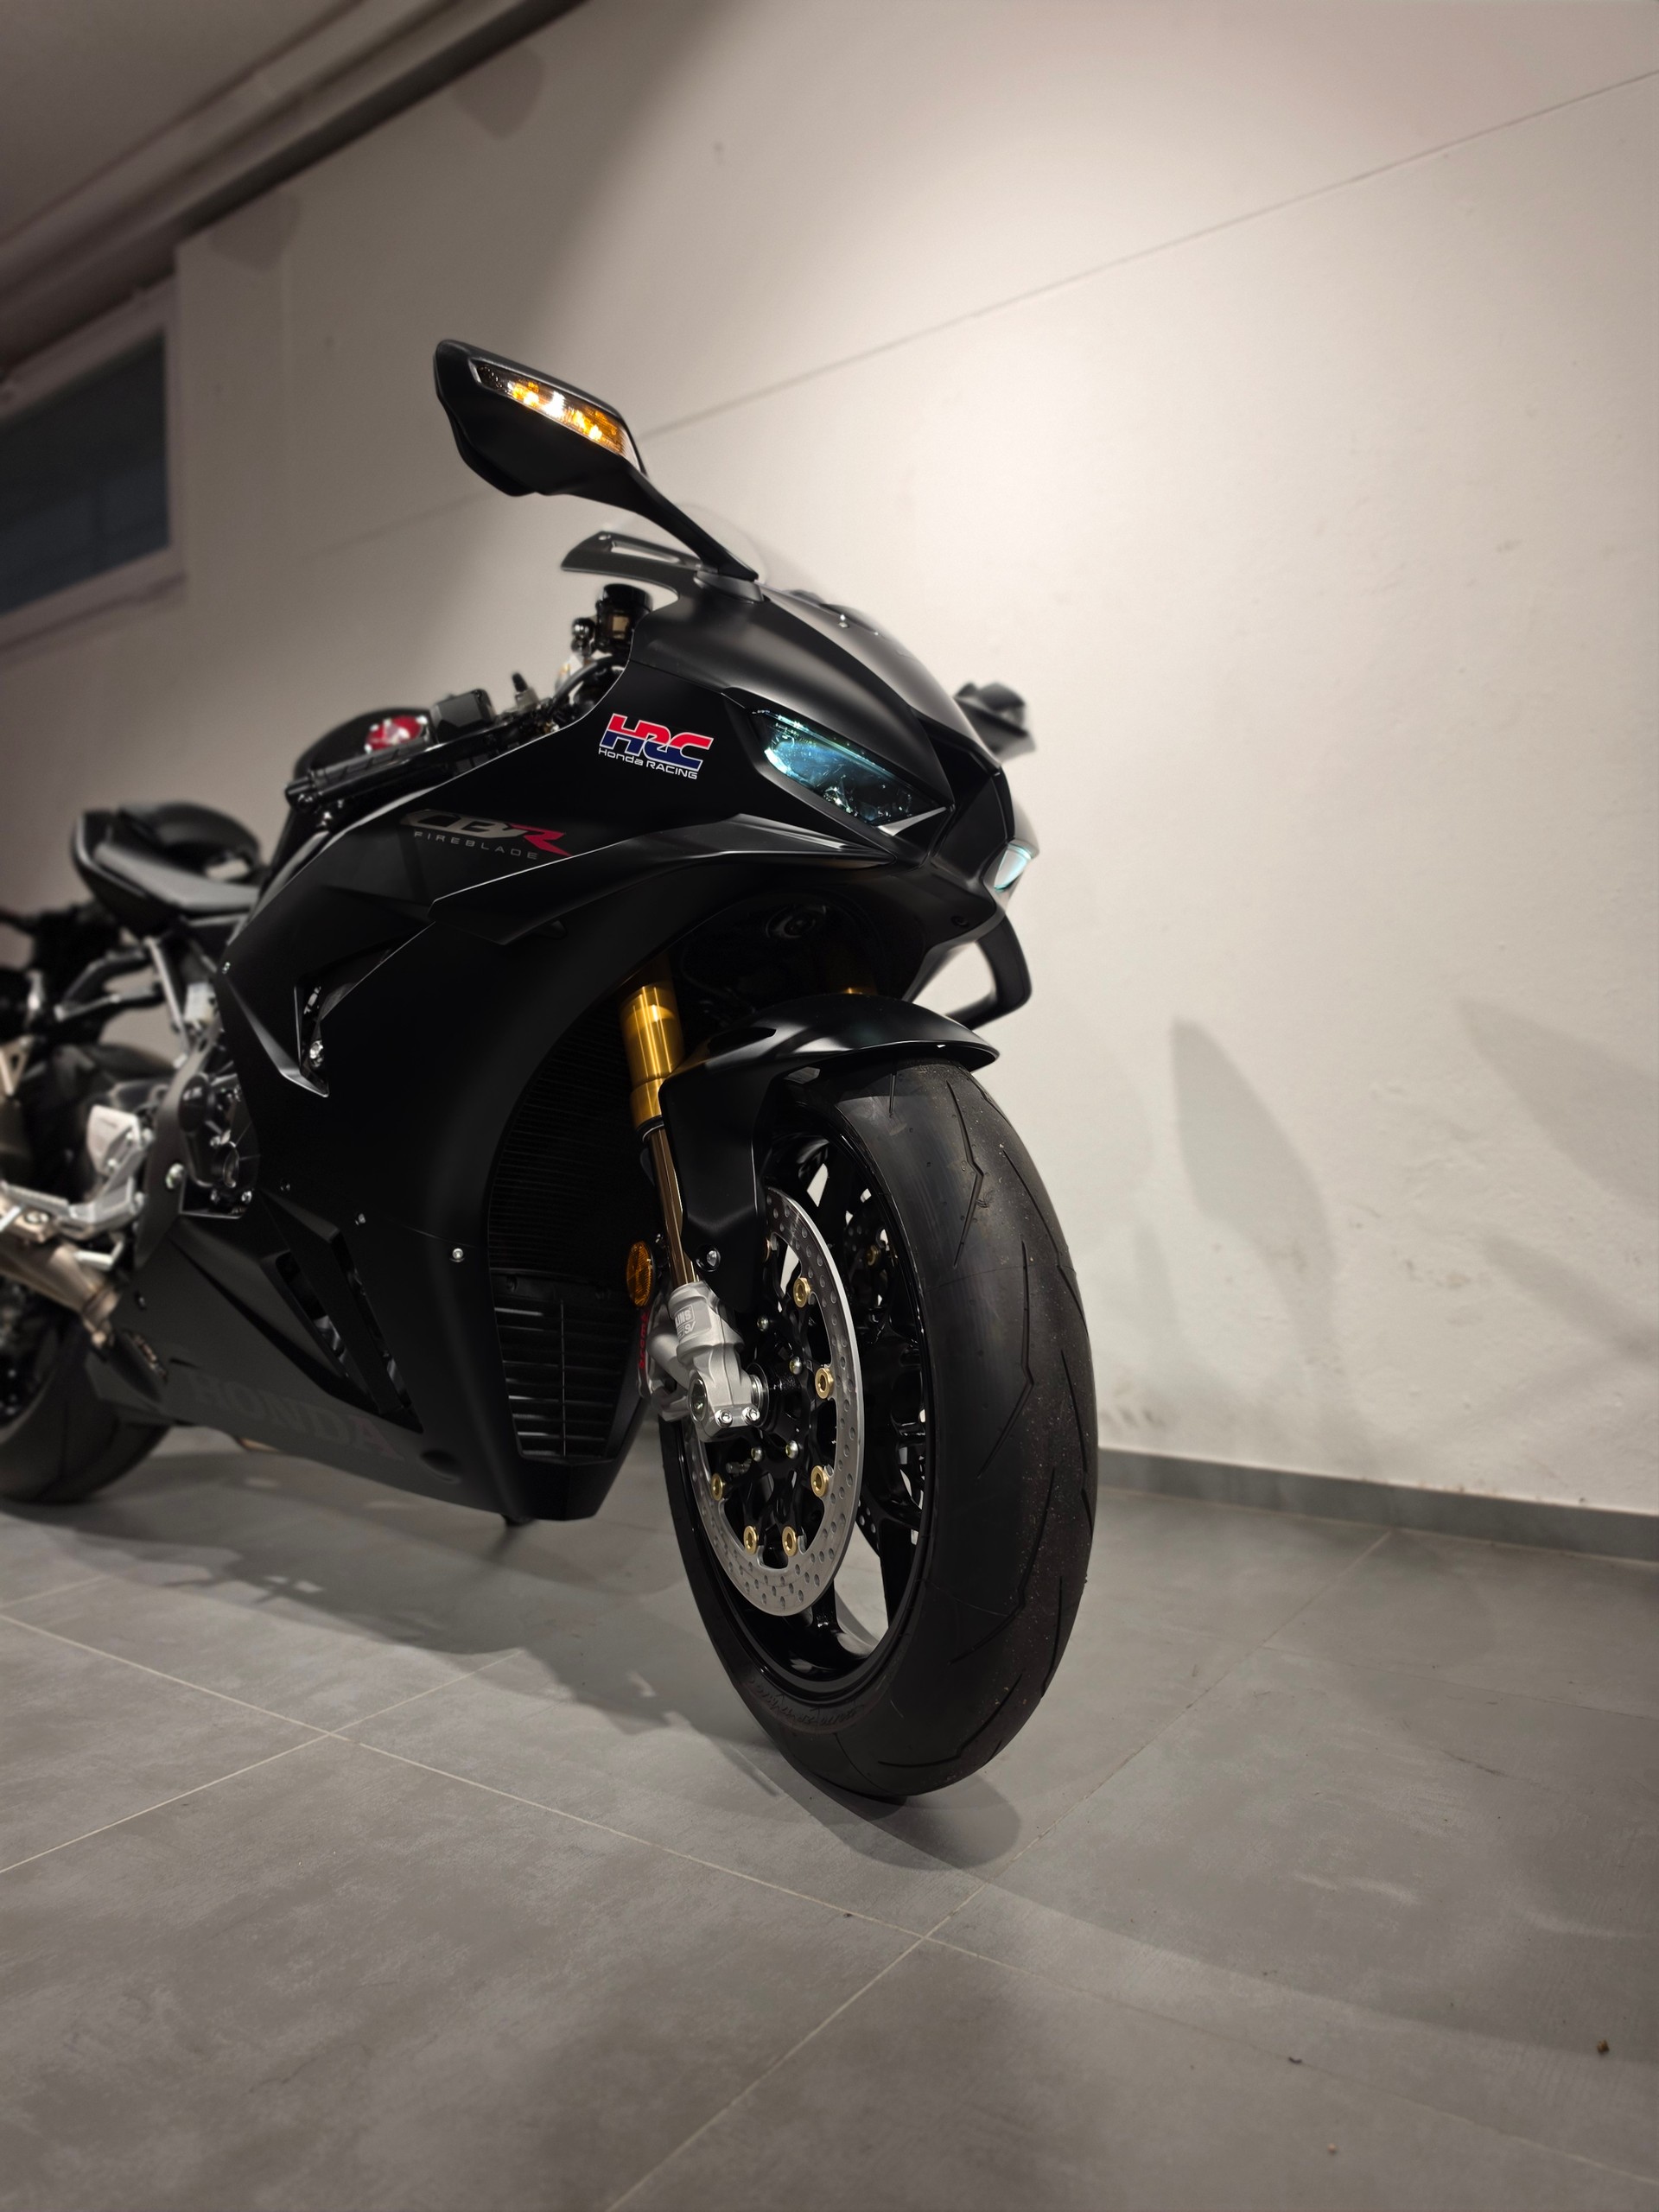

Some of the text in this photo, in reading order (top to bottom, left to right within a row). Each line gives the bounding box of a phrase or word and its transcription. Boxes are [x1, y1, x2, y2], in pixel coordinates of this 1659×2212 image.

[598, 747, 698, 779] Honda RACING
[599, 713, 715, 772] HRC
[399, 809, 573, 858] CBR
[413, 830, 539, 861] FIREBLADE
[183, 1369, 405, 1461] HONDA
